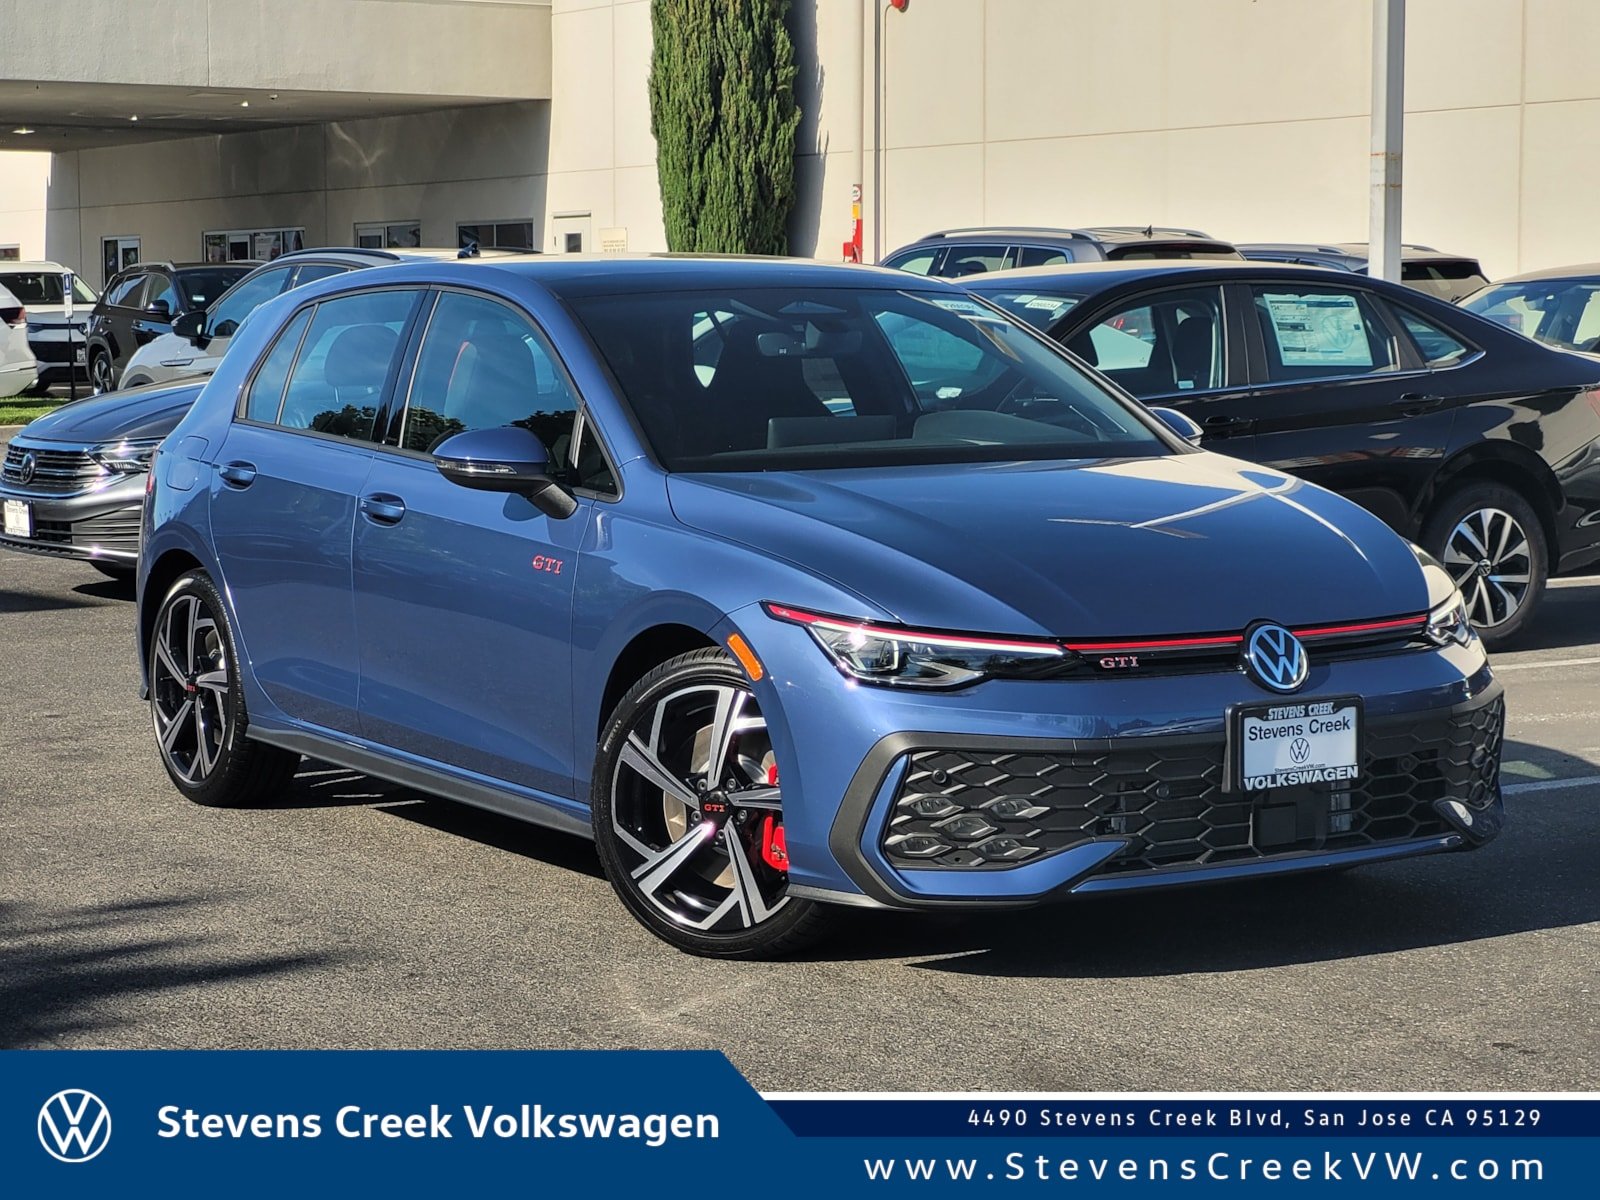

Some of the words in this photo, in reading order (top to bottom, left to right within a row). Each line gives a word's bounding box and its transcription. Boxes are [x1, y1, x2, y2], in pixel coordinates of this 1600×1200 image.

[532, 554, 563, 575] GTI
[1099, 656, 1140, 669] GTI
[1268, 705, 1305, 721] STEVENS
[1308, 702, 1335, 716] CREEK
[1248, 723, 1303, 741] Stevens
[1309, 716, 1351, 734] Creek
[1243, 765, 1359, 791] VOLKSWAGEN
[703, 803, 726, 813] GTI
